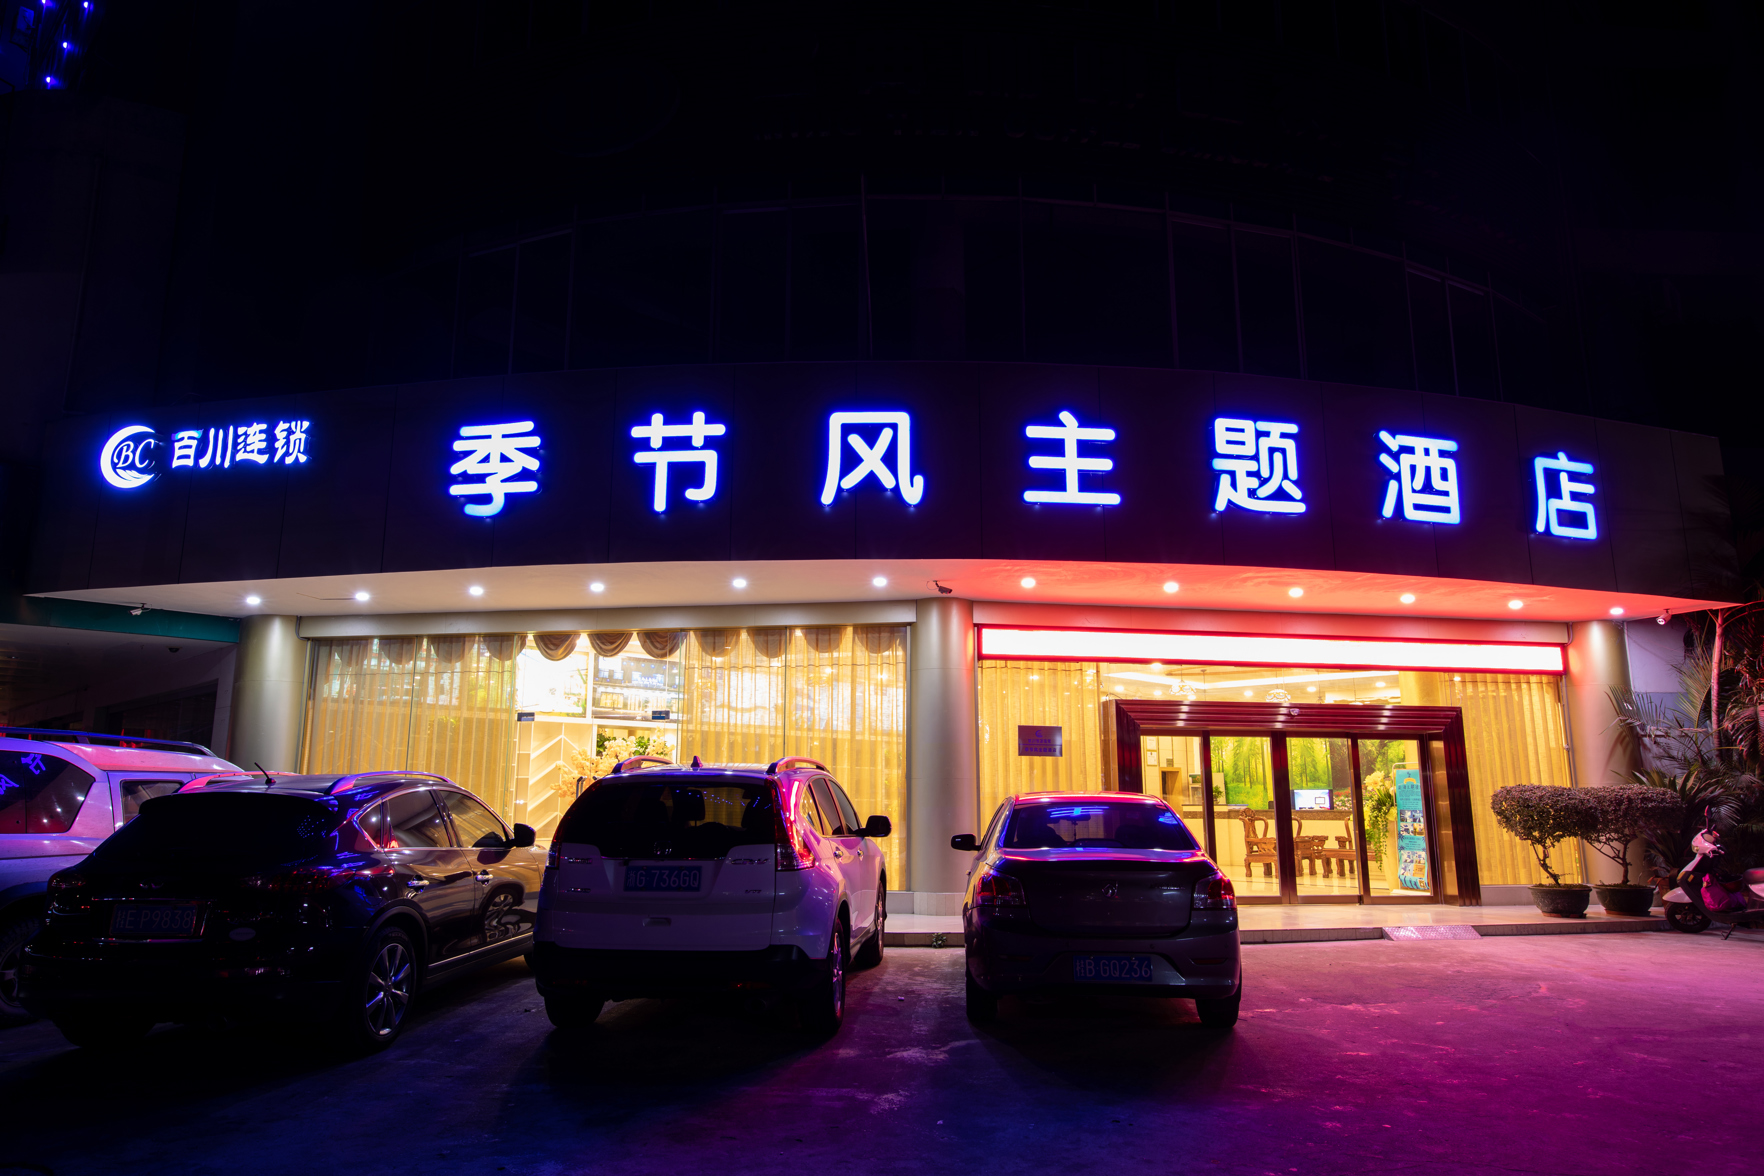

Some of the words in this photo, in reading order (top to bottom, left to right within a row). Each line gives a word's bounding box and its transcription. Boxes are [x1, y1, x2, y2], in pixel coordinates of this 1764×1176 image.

[113, 438, 155, 468] BC
[171, 420, 311, 469] 百川连锁
[449, 411, 1598, 539] 季节风主题酒店
